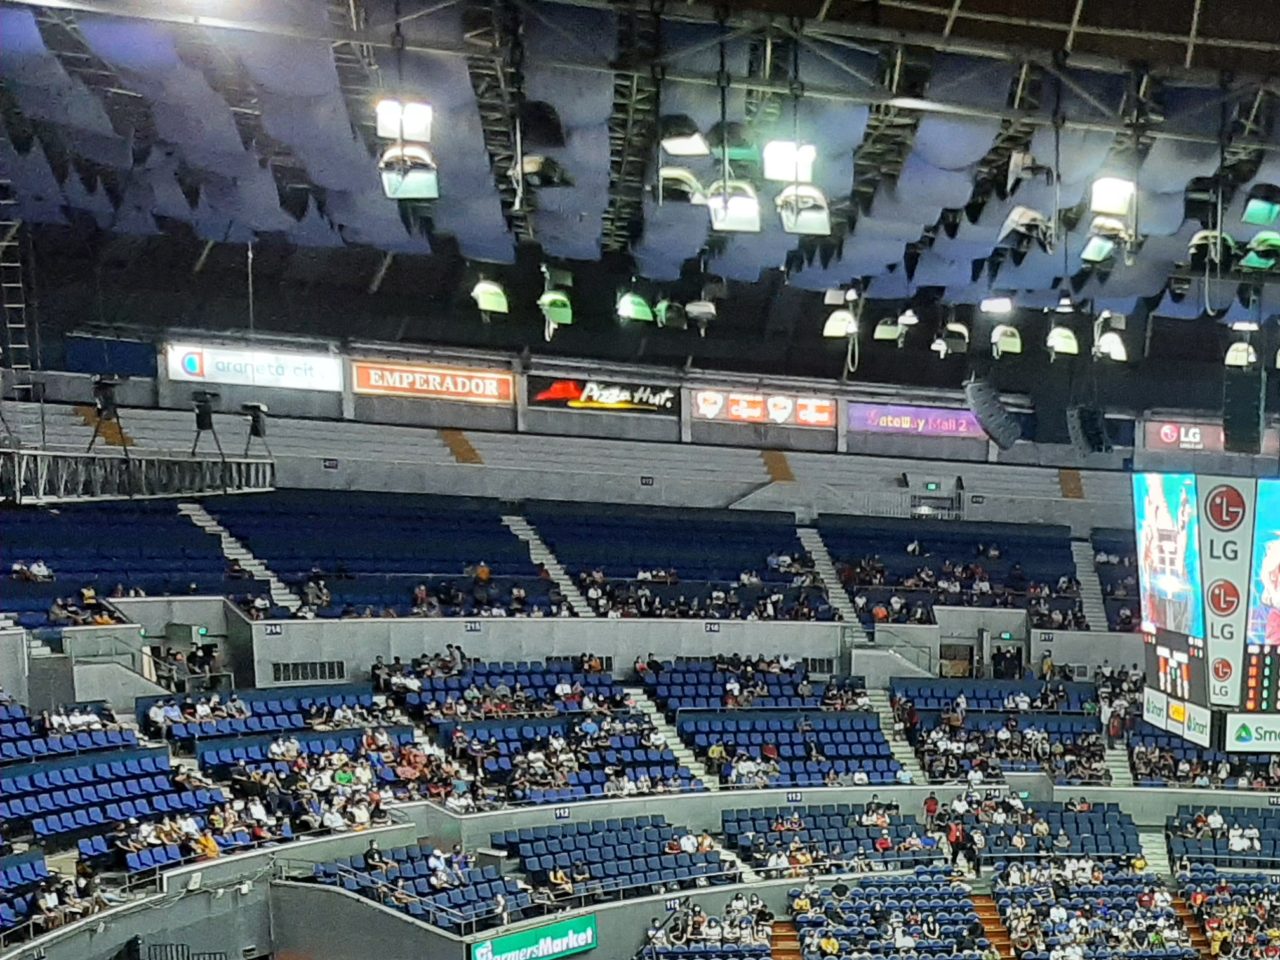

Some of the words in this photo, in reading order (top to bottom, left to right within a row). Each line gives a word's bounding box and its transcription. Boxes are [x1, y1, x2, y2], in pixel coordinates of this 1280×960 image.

[368, 368, 499, 396] EMPERADOR
[579, 381, 632, 404] Pizza
[928, 416, 957, 431] Mall
[958, 419, 969, 432] 2
[1180, 427, 1201, 442] LG
[1208, 538, 1239, 561] LG
[1210, 622, 1235, 640] LG
[1212, 684, 1229, 697] LG
[556, 808, 569, 818] 112
